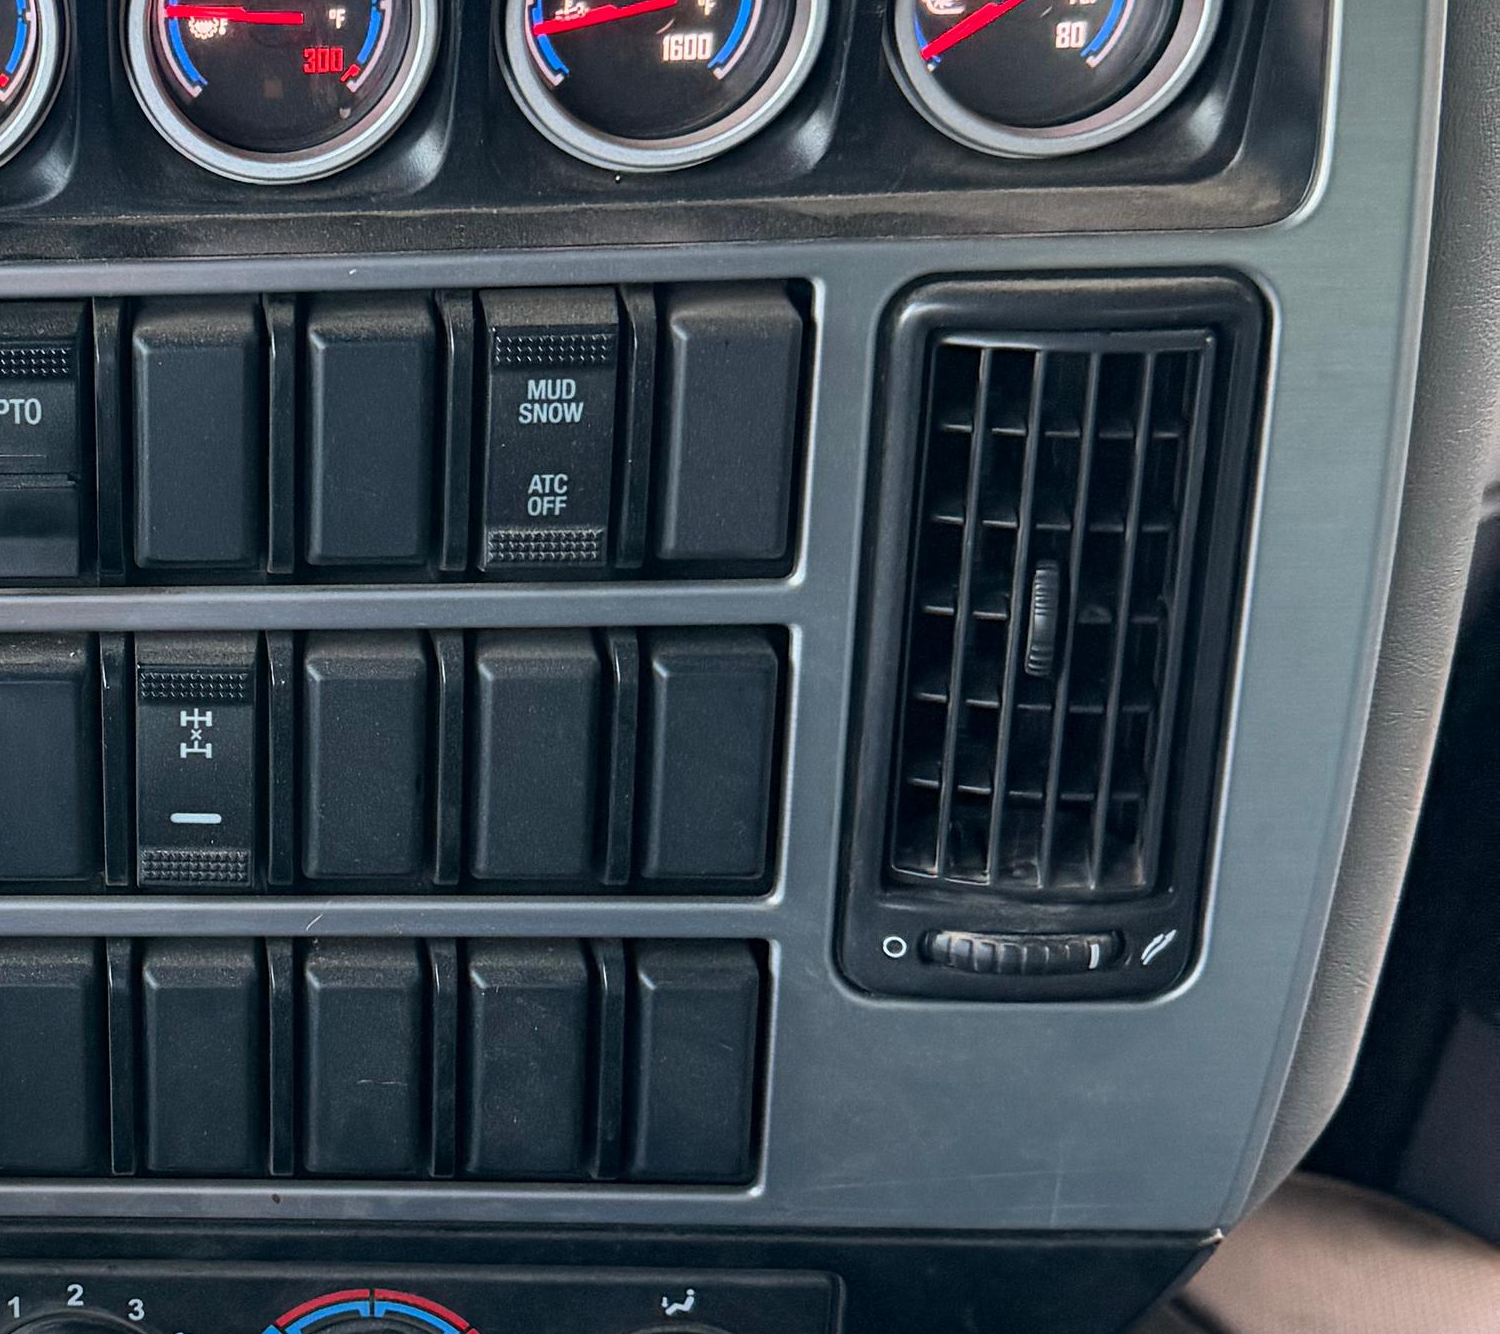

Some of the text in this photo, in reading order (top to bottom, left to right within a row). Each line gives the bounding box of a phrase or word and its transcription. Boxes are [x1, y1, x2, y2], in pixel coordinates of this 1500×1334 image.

[662, 33, 713, 61] 1600
[1055, 22, 1087, 49] 80
[303, 47, 344, 74] 300
[527, 379, 576, 400] MUD
[518, 401, 584, 424] SNOW
[527, 473, 568, 494] ATC
[527, 496, 568, 516] OFF
[7, 1296, 21, 1318] 1
[67, 1284, 84, 1307] 2
[128, 1298, 145, 1321] 3
